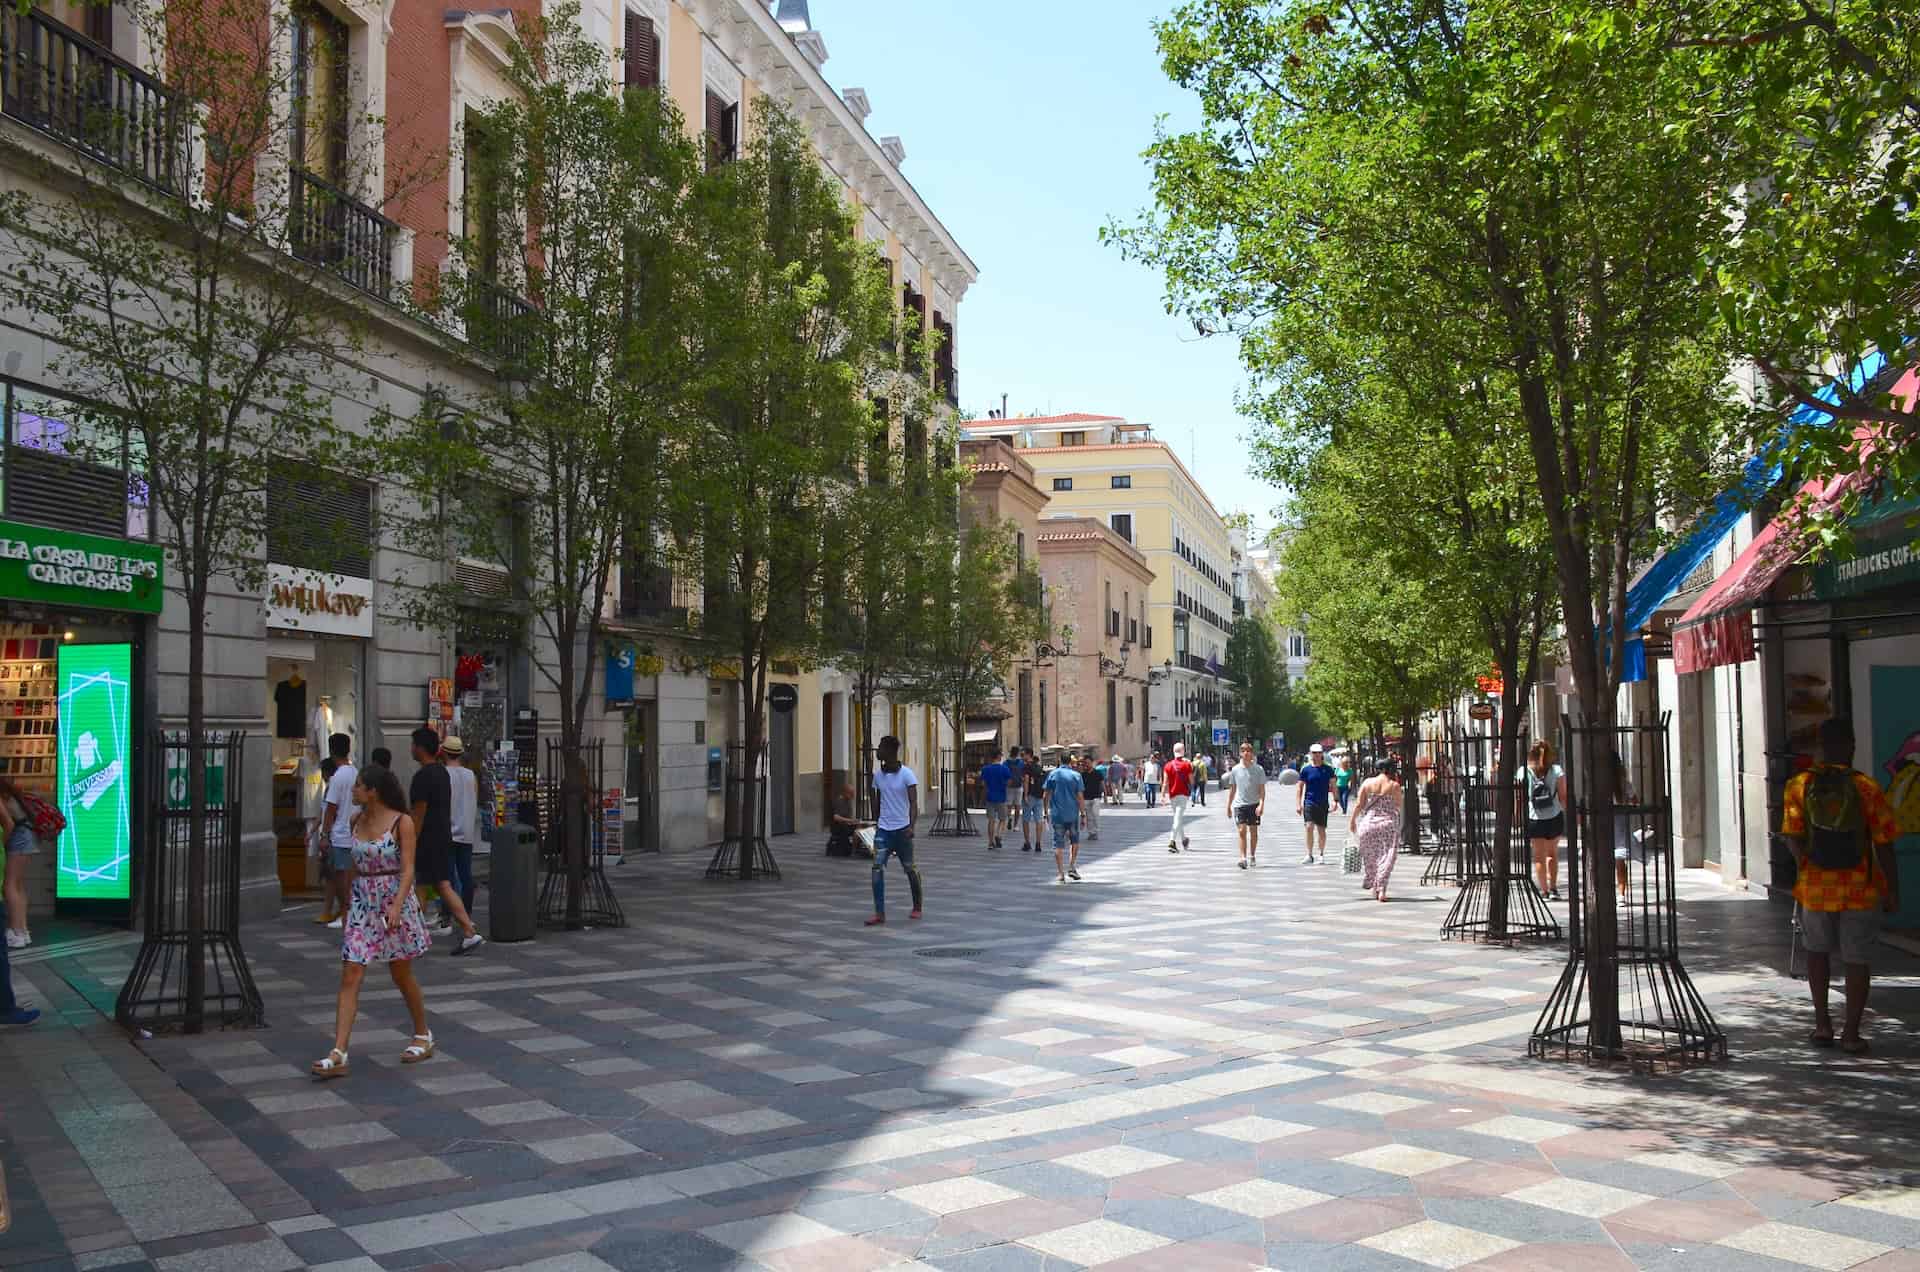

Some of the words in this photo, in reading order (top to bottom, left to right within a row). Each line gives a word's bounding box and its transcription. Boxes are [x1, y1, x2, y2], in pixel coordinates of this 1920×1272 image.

[0, 538, 32, 561] LA
[32, 544, 89, 569] CASA
[89, 552, 118, 573] DE
[118, 556, 158, 579] LAS
[1838, 551, 1890, 582] STARBUCKS
[28, 563, 133, 593] CARCASAS
